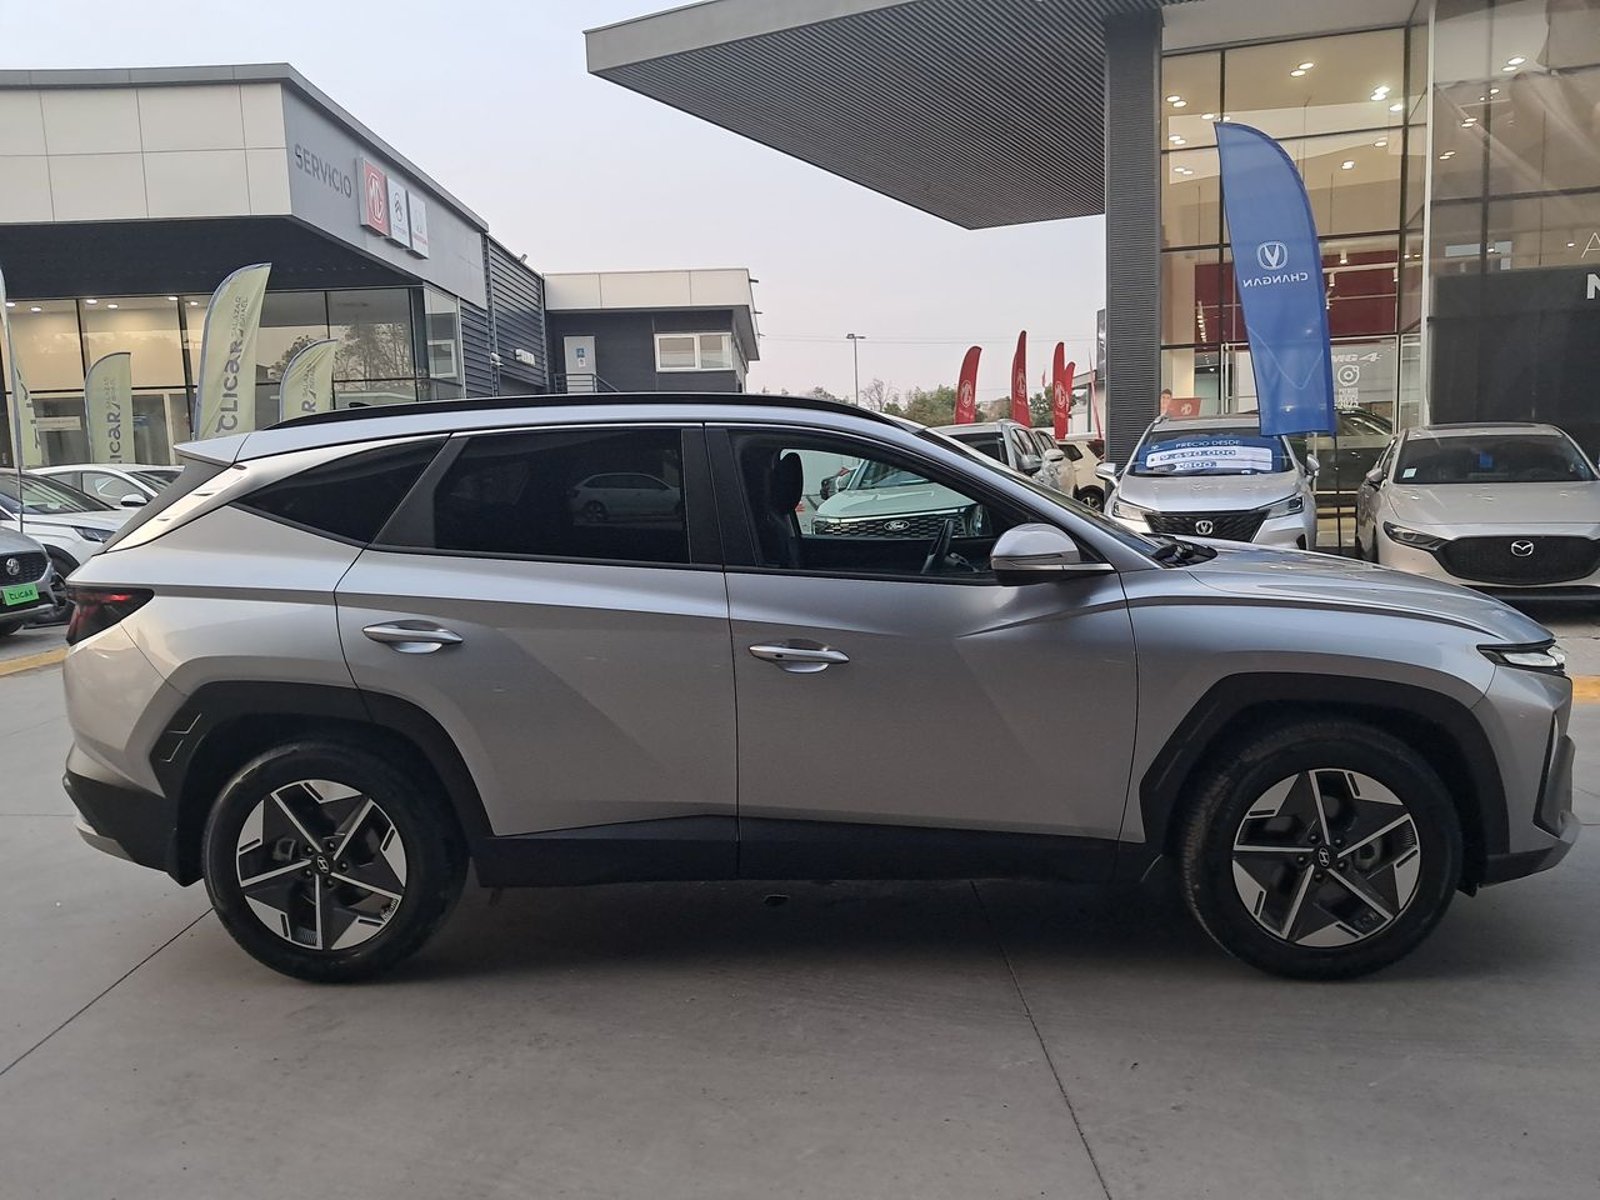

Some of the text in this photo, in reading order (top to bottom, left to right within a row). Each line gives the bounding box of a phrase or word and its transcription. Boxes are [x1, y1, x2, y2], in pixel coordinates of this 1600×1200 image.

[294, 143, 353, 199] SERVICIO
[1175, 439, 1241, 448] PRECIO DESDE
